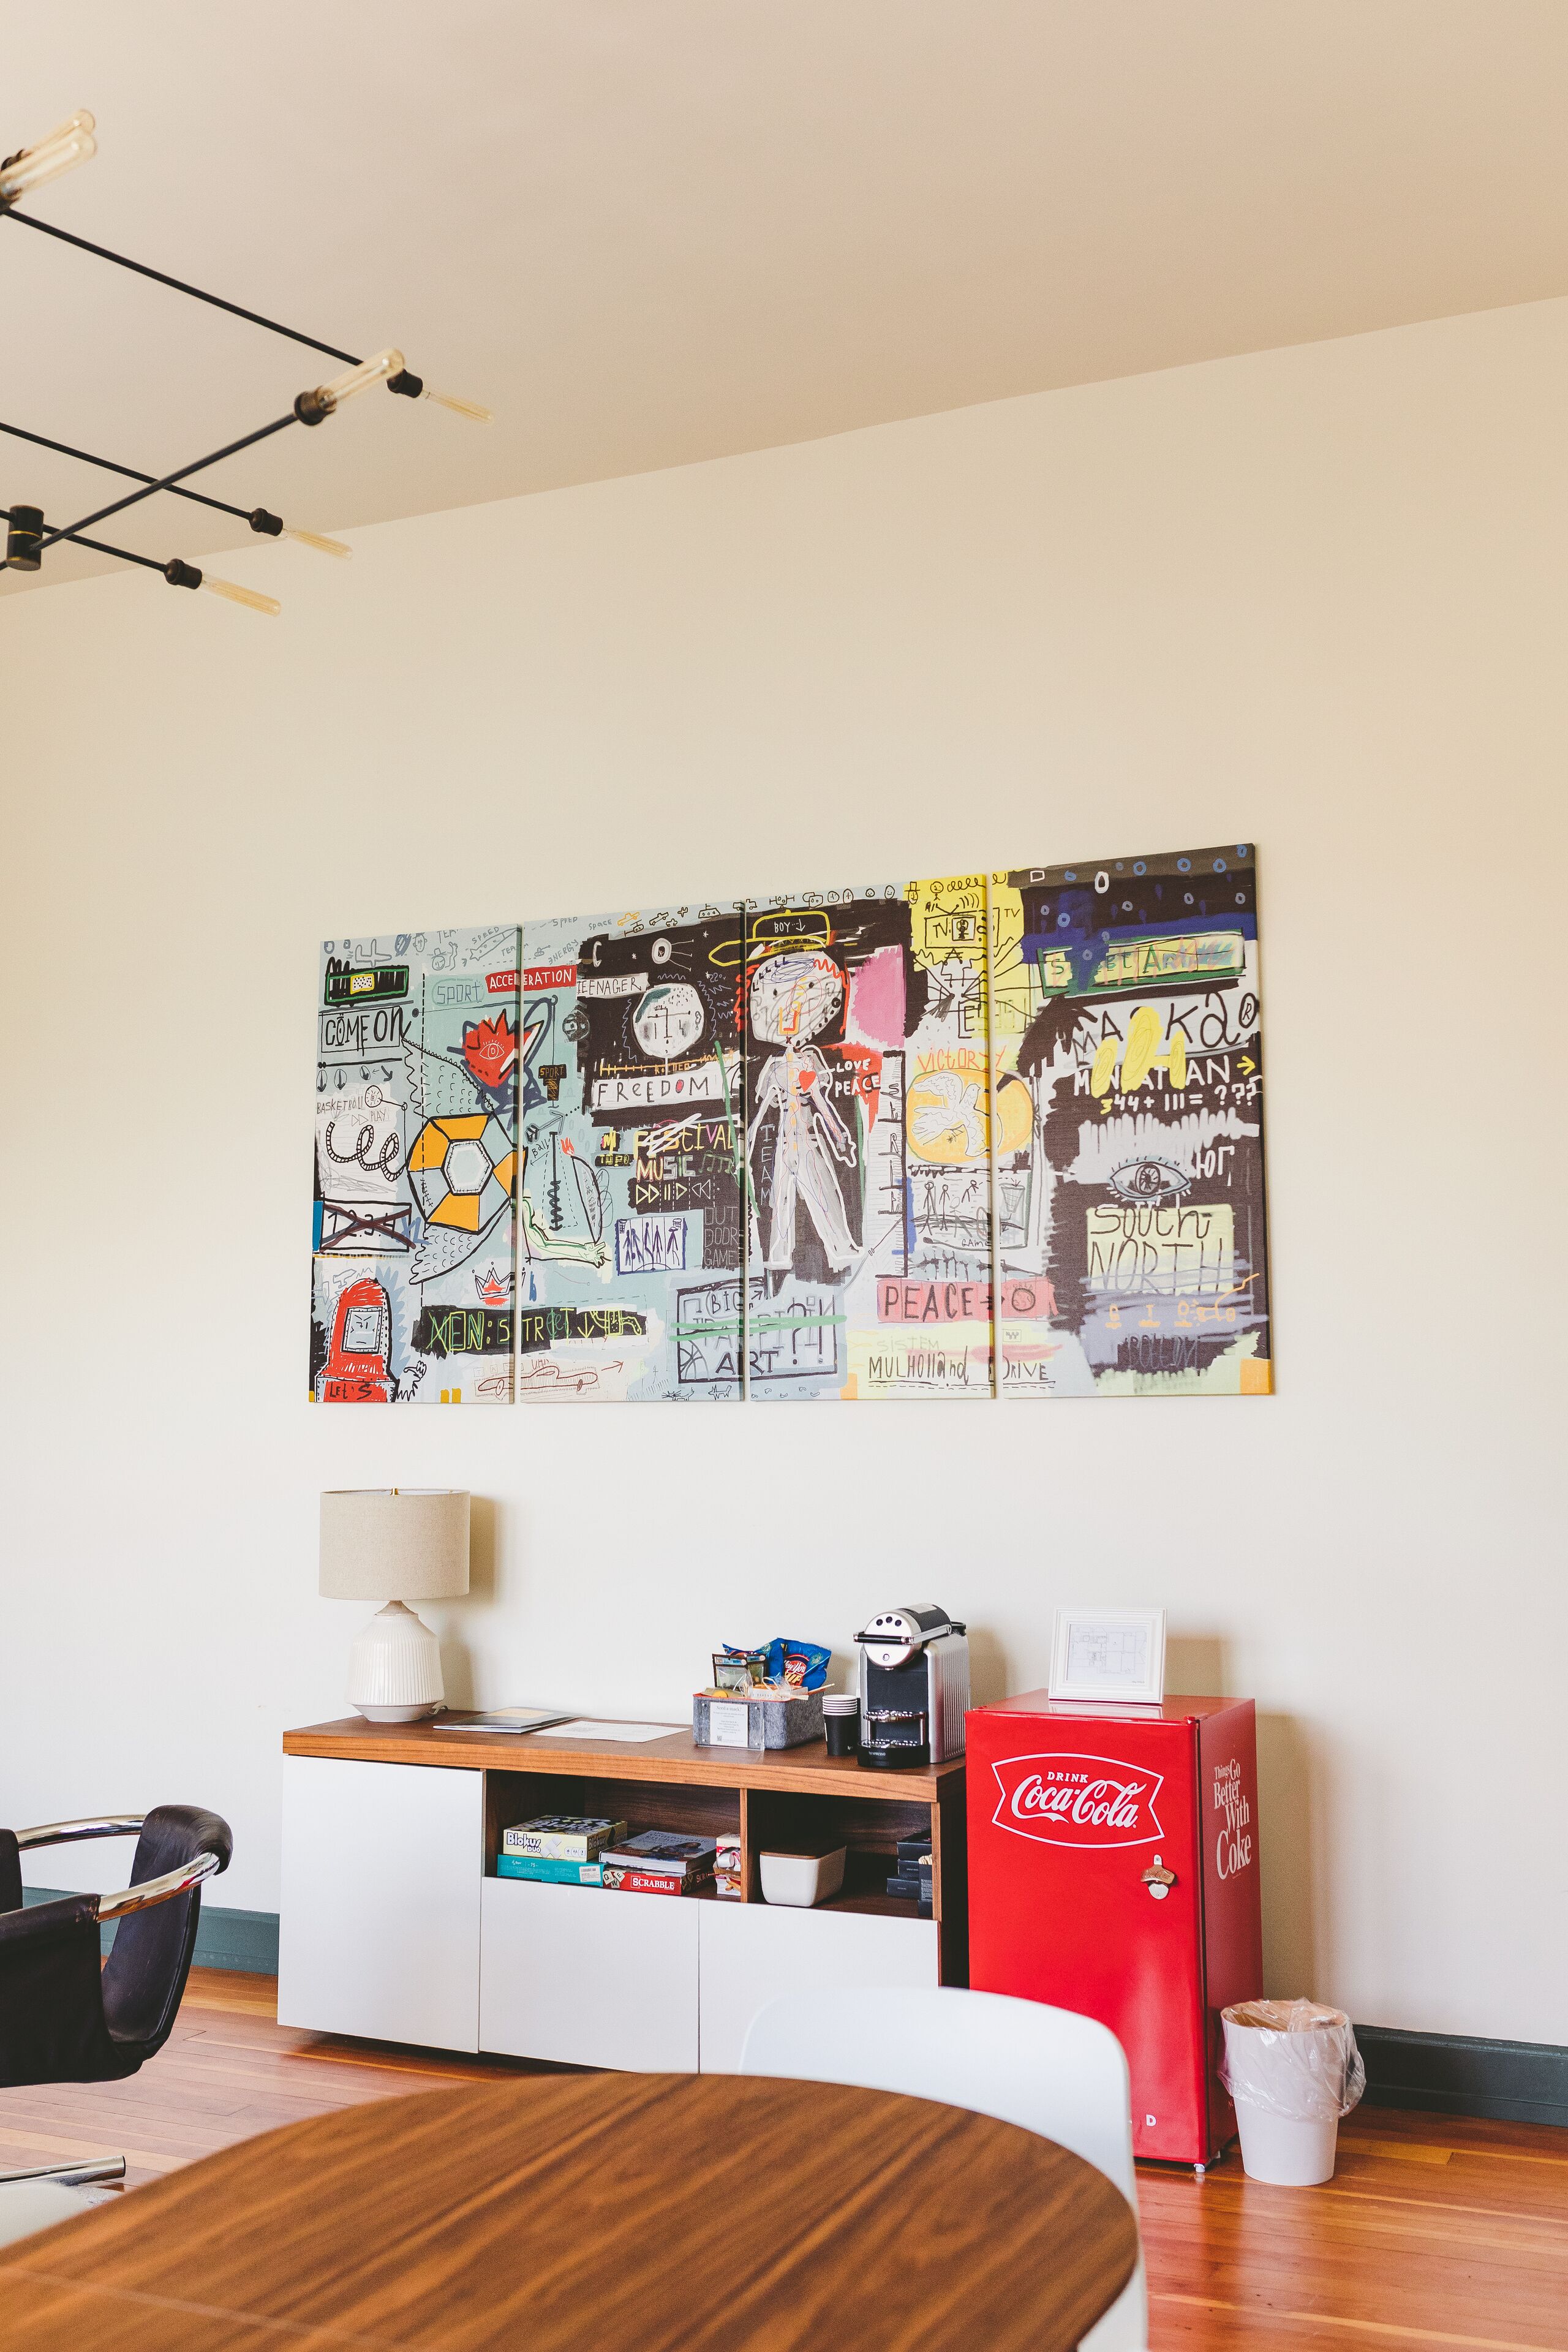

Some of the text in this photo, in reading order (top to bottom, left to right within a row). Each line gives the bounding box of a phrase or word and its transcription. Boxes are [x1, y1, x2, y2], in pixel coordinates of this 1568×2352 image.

[1005, 908, 1020, 918] TV
[472, 927, 500, 945] SPEED
[774, 921, 791, 933] BOY
[577, 978, 642, 995] TEENAGER
[540, 1066, 565, 1077] SPORT
[836, 1058, 871, 1073] LOVE
[835, 1075, 881, 1098] PEACE
[704, 1248, 736, 1267] GAME
[1090, 1238, 1223, 1296] NORTH
[884, 1283, 974, 1322] PEACE
[1047, 1771, 1089, 1784] DRINK
[1230, 1758, 1241, 1781] Go
[1011, 1774, 1147, 1829] Coca-Cola
[1213, 1779, 1240, 1810] Better
[1225, 1795, 1250, 1834] With
[506, 1832, 541, 1850] Blokus
[1216, 1828, 1252, 1880] Coke
[632, 1877, 675, 1890] SCRABBLE
